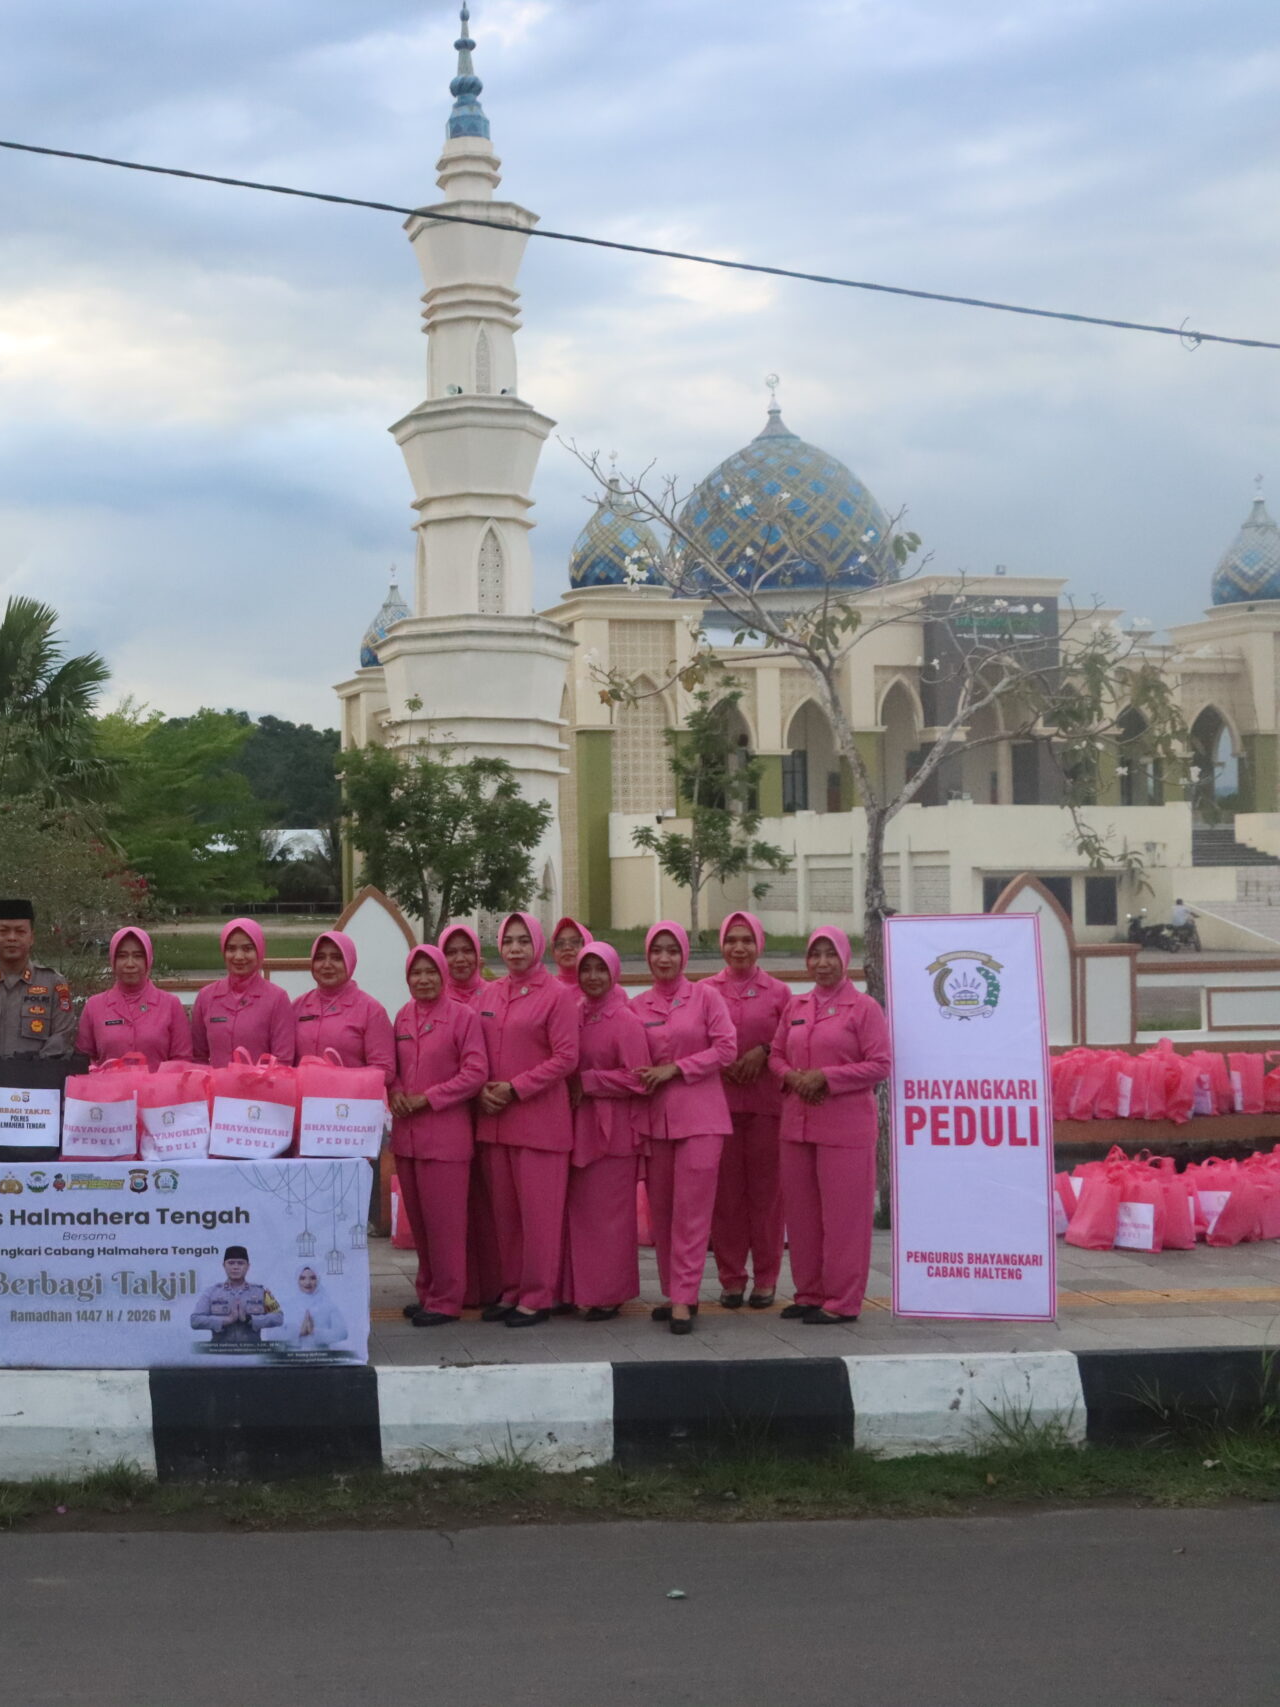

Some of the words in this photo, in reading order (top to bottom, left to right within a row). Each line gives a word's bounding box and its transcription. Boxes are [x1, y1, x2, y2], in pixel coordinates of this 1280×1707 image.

[903, 1079, 1038, 1100] BHAYANGKARI
[10, 1114, 30, 1122] POLRES
[215, 1122, 289, 1138] BHAYANGKARI
[304, 1123, 377, 1133] BHAYANGKARI
[904, 1105, 1040, 1147] PEDULI
[72, 1137, 121, 1145] PEDULI
[226, 1137, 276, 1149] PEDULI
[316, 1137, 365, 1146] PEDULI
[9, 1208, 150, 1226] Halmahera
[155, 1206, 251, 1230] Tengah
[62, 1231, 117, 1241] Bersama
[43, 1247, 95, 1259] Cabang
[97, 1246, 169, 1256] Halmahera
[171, 1245, 219, 1258] Tengah
[906, 1251, 964, 1264] PENGURUS
[967, 1252, 1043, 1267] BHAYANGKARI
[927, 1265, 971, 1278] CABANG
[974, 1266, 1023, 1280] HALTENG
[111, 1269, 197, 1301] Takjil
[10, 1309, 72, 1323] Ramadhan
[77, 1309, 102, 1322] 1447
[106, 1309, 114, 1322] H
[127, 1309, 156, 1322] 2026
[160, 1309, 171, 1322] M
